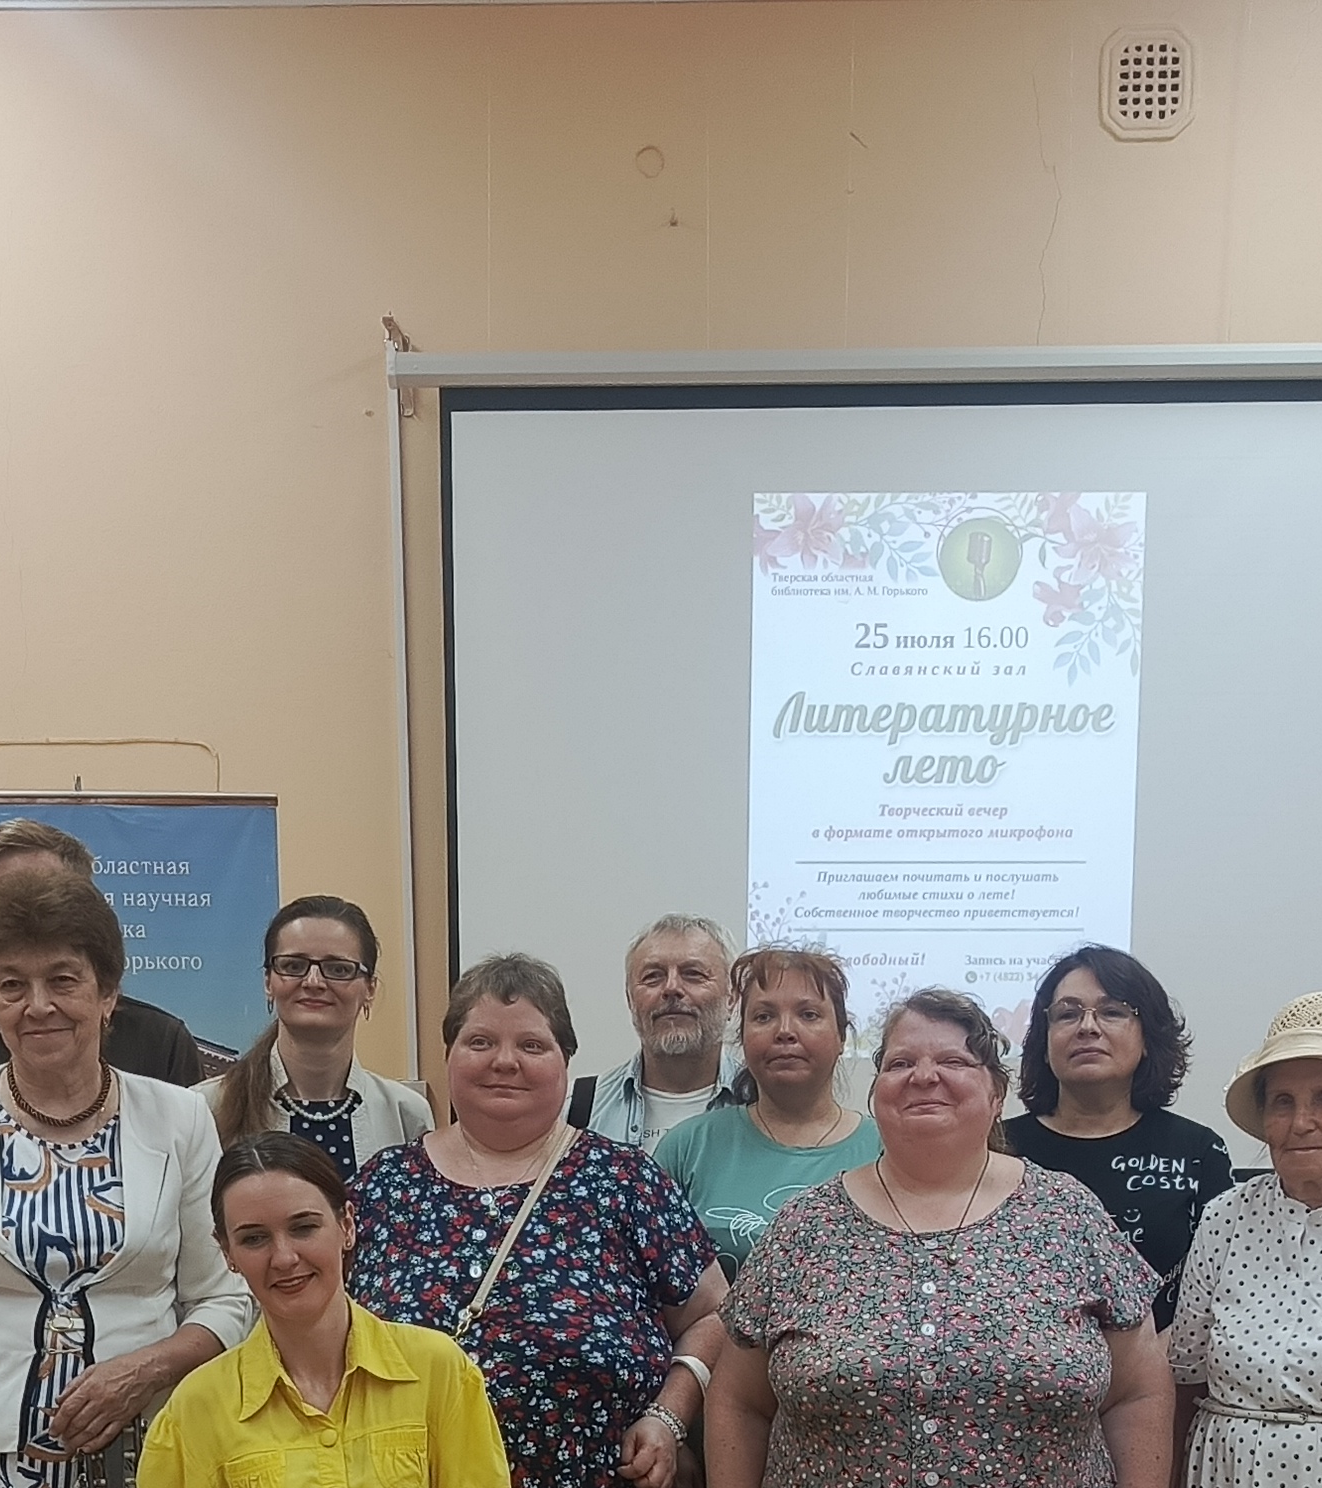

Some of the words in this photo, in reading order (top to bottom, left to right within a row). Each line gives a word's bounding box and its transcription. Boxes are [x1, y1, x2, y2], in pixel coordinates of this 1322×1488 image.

[771, 572, 818, 584] Тверская
[821, 572, 874, 583] областная
[771, 586, 831, 596] библиотека
[834, 588, 852, 596] им.
[882, 586, 928, 598] Горького
[854, 622, 889, 649] 25
[895, 635, 955, 649] июля
[963, 626, 1029, 649] 16.00
[850, 660, 981, 676] Славянский
[992, 664, 1026, 676] зал
[773, 690, 1116, 746] Литературное
[882, 754, 1007, 784] лето
[878, 803, 964, 820] Творческий
[967, 807, 1008, 820] вечер
[811, 827, 820, 838] в
[824, 825, 893, 842] формате
[896, 827, 983, 842] открытого
[987, 825, 1074, 842] микрофона
[91, 855, 191, 875] бластная
[816, 871, 899, 885] Приглашаем
[902, 873, 970, 883] почитать
[973, 873, 982, 883] и
[985, 873, 1059, 885] послушать
[122, 892, 212, 912] научная
[857, 889, 919, 901] любимые
[922, 891, 964, 901] стихи
[967, 891, 975, 901] о
[978, 889, 1016, 901] лете!
[794, 906, 878, 919] Собственное
[882, 907, 960, 921] творчество
[963, 906, 1080, 921] приветствуется!
[124, 955, 203, 974] рького
[964, 955, 1006, 966] Запись
[1009, 957, 1023, 966] на
[1111, 1153, 1185, 1173] GOLDEN
